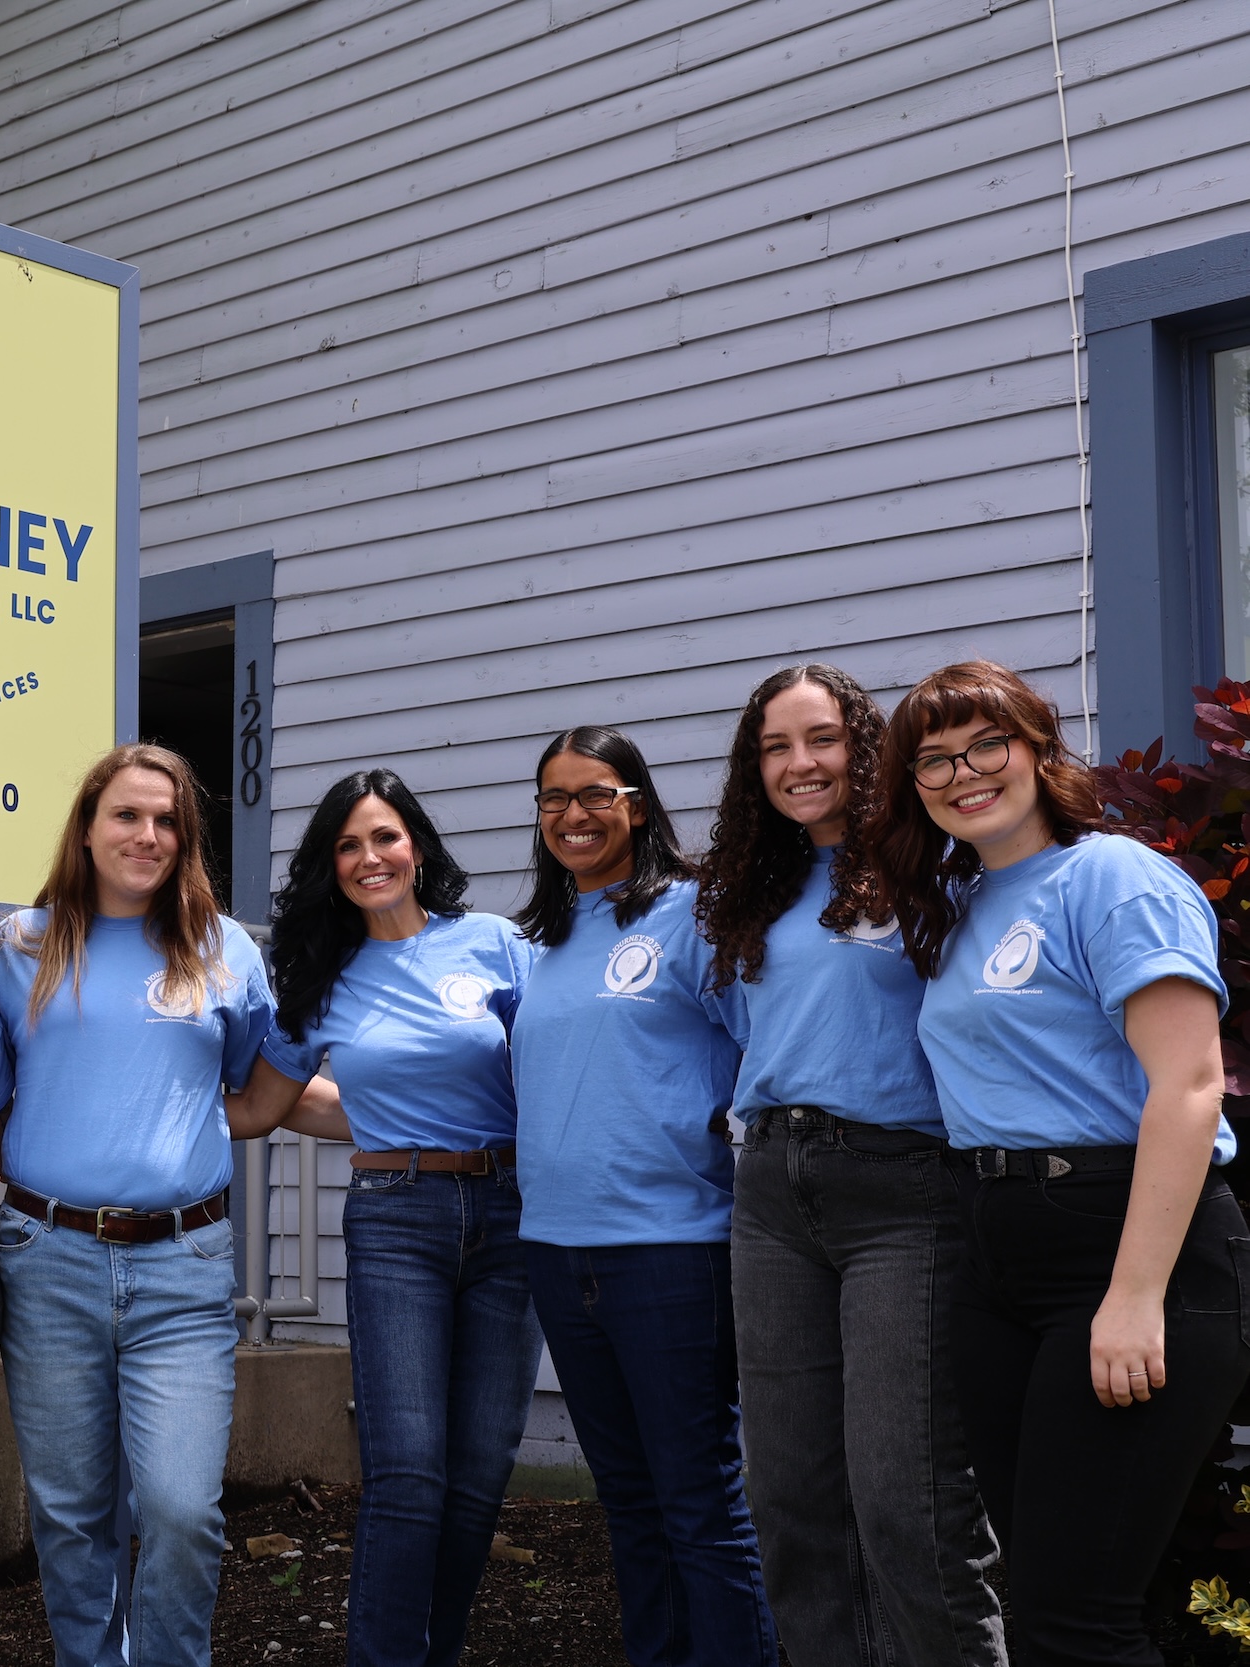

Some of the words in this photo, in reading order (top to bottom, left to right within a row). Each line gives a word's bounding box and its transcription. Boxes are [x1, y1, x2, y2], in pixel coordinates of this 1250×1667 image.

[11, 592, 56, 625] LLC
[240, 660, 263, 807] 1200
[612, 934, 645, 954] JOURNEY
[644, 936, 655, 945] TO
[652, 942, 664, 959] YOU
[434, 972, 464, 989] JOURNEY
